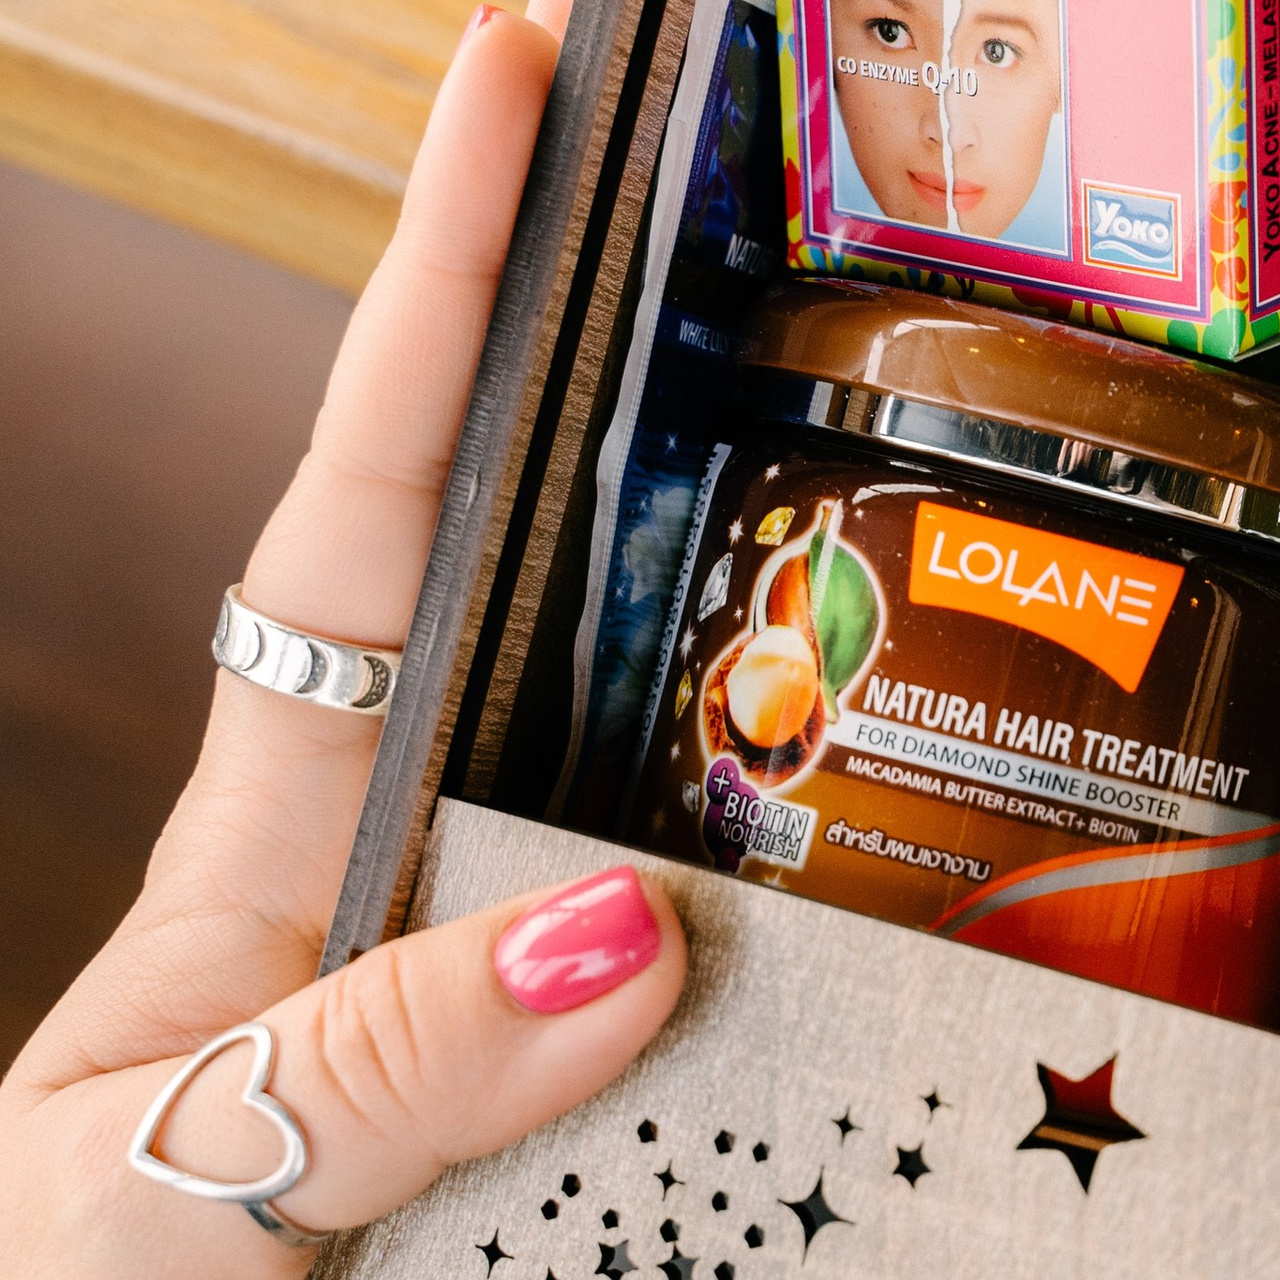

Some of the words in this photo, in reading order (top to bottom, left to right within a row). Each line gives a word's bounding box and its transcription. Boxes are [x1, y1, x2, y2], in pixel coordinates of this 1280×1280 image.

[837, 56, 858, 75] CO
[860, 60, 919, 87] ENZYME
[920, 61, 980, 99] Q-10
[1261, 102, 1279, 178] ACNE
[1092, 201, 1171, 246] YOKO
[1262, 184, 1280, 263] YOKO
[678, 319, 709, 351] WHITE
[928, 530, 1157, 627] LOLANE
[856, 723, 896, 749] FOR
[902, 735, 1011, 778] DIAMOND
[1016, 765, 1081, 797] SHINE
[1085, 782, 1182, 821] BOOSTER
[862, 674, 988, 741] NATURA
[993, 707, 1075, 762] HAIR
[1082, 728, 1250, 803] TREATMENT
[723, 791, 810, 841] BIOTIN
[846, 756, 943, 795] MACADAMIA
[944, 782, 1005, 811] BUTTER
[1088, 816, 1141, 844] BIOTIN
[719, 819, 801, 861] NOURISH
